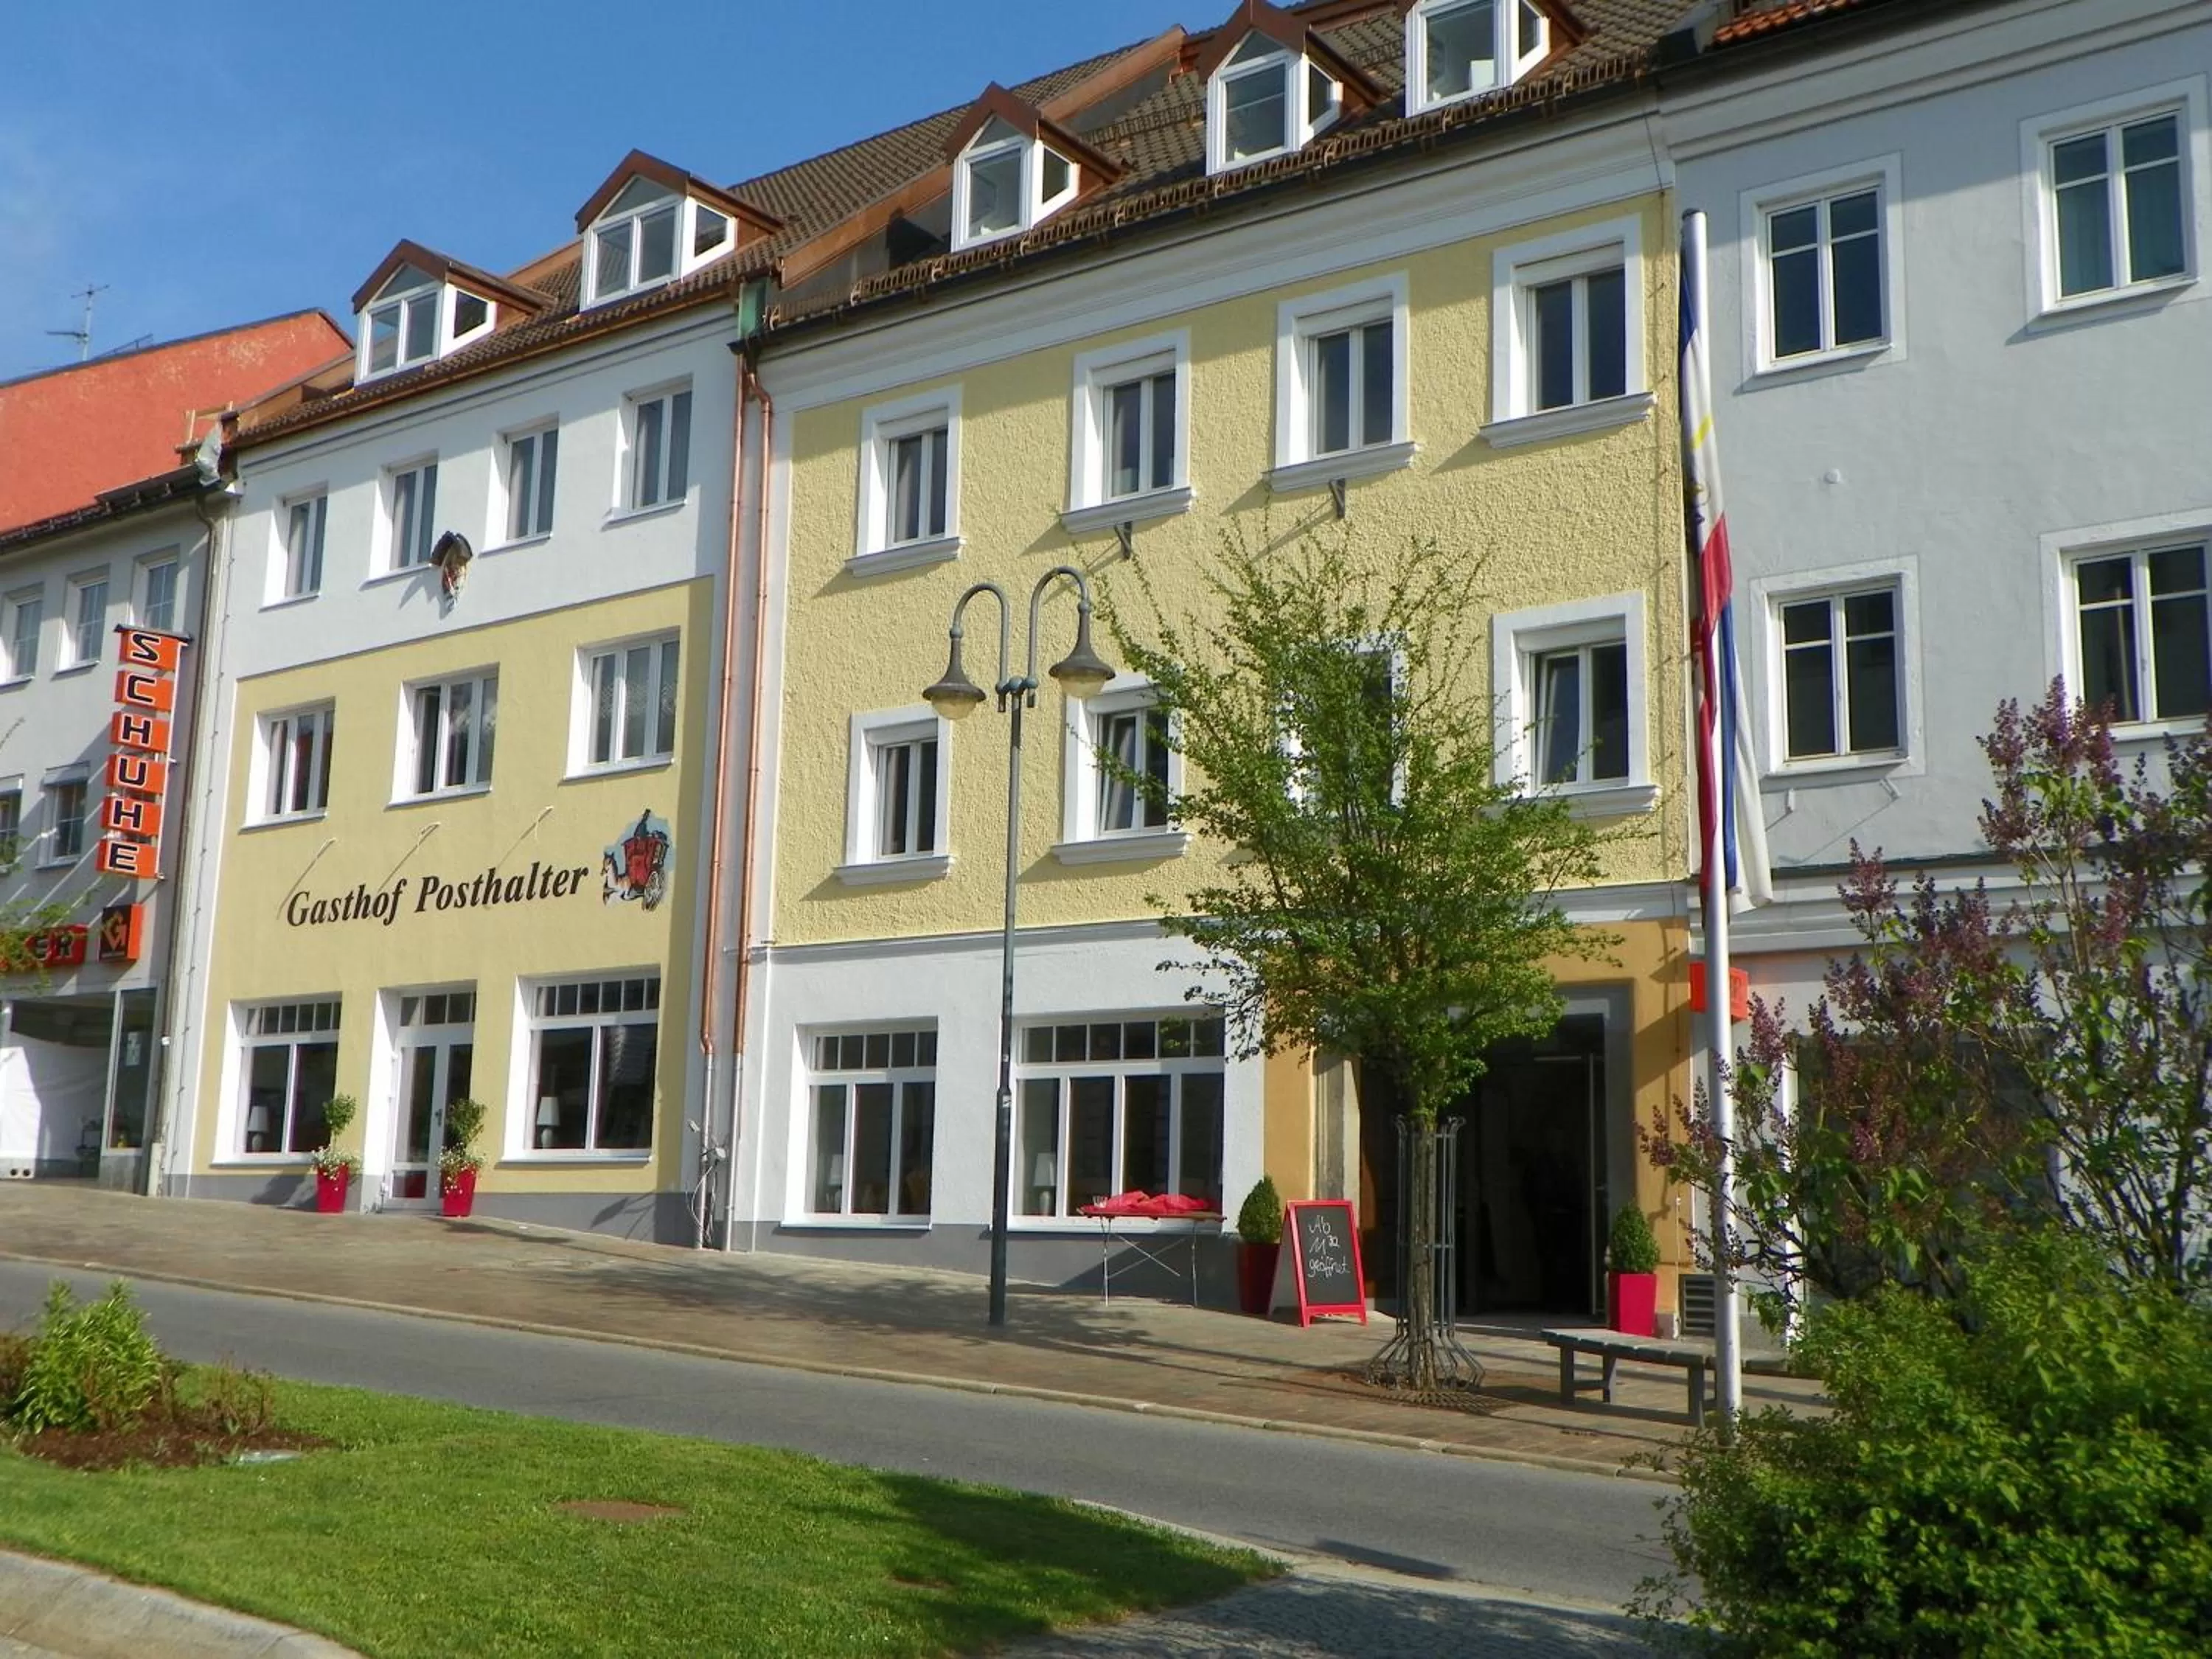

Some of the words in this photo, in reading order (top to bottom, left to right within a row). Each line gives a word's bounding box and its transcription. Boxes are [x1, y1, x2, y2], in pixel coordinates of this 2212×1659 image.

[108, 632, 160, 872] SCHUHE
[287, 880, 407, 927] Gasthof
[414, 861, 590, 914] Posthalter
[1309, 1215, 1331, 1235] Ab
